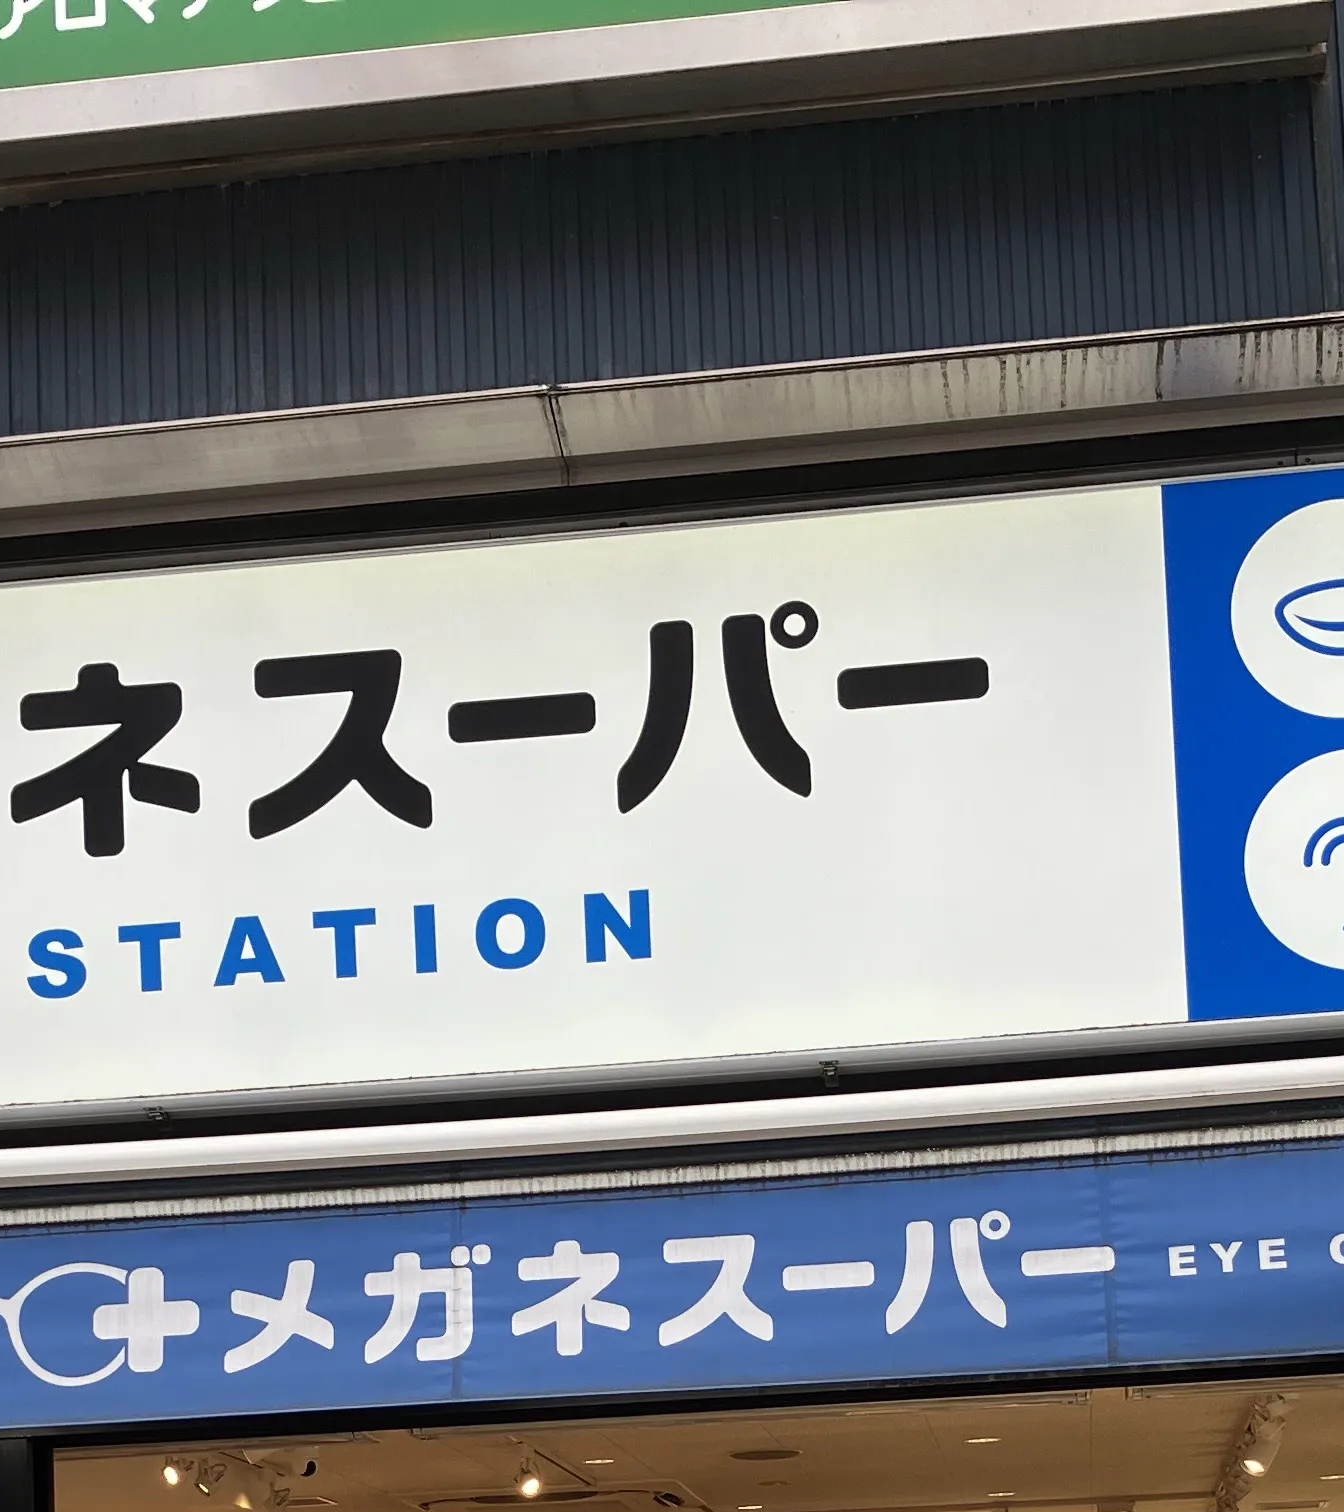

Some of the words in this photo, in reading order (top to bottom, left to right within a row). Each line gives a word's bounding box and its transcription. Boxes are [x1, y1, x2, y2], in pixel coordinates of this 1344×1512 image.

[26, 890, 659, 1002] STATION
[224, 1209, 1116, 1373] メガネスーパー
[1168, 1244, 1288, 1277] EYE
